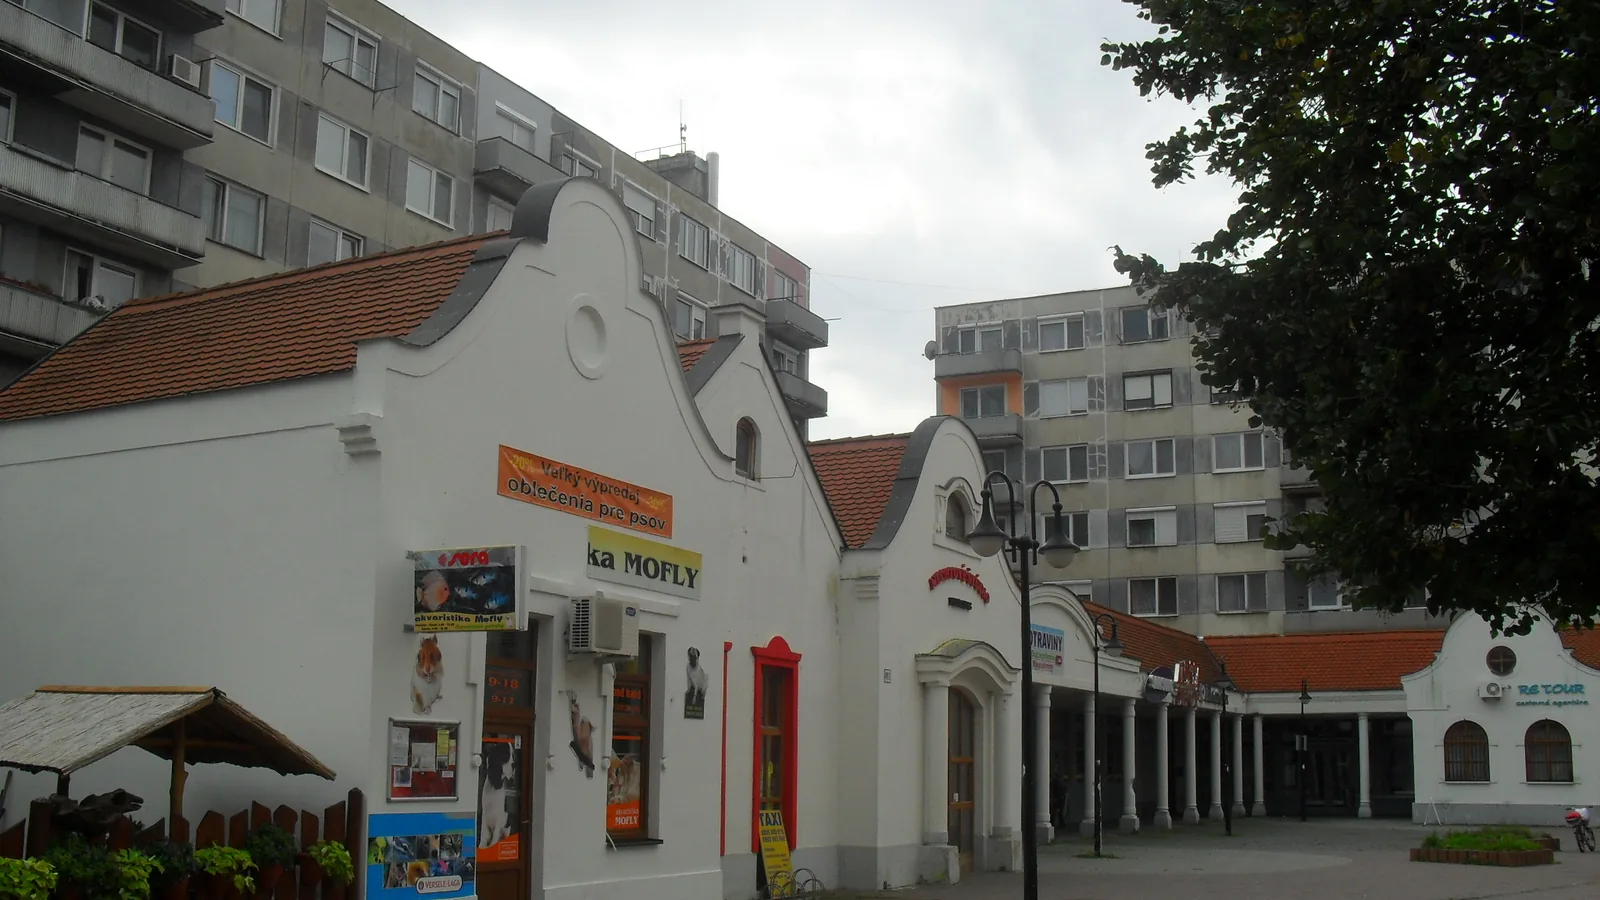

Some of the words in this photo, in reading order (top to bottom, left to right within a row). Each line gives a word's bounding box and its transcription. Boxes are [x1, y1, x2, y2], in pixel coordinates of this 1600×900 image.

[541, 461, 582, 488] Veľký
[585, 477, 640, 505] výpredaj
[508, 477, 594, 512] oblečenia
[599, 503, 625, 521] pre
[629, 510, 667, 531] psov
[587, 542, 615, 570] ka
[624, 551, 699, 589] MOFLY
[415, 613, 471, 623] akvaristika
[475, 615, 503, 623] Mofly
[1518, 684, 1540, 695] RE
[1541, 684, 1585, 695] TOUR
[615, 816, 640, 825] MOFLY
[760, 812, 782, 826] TAXI
